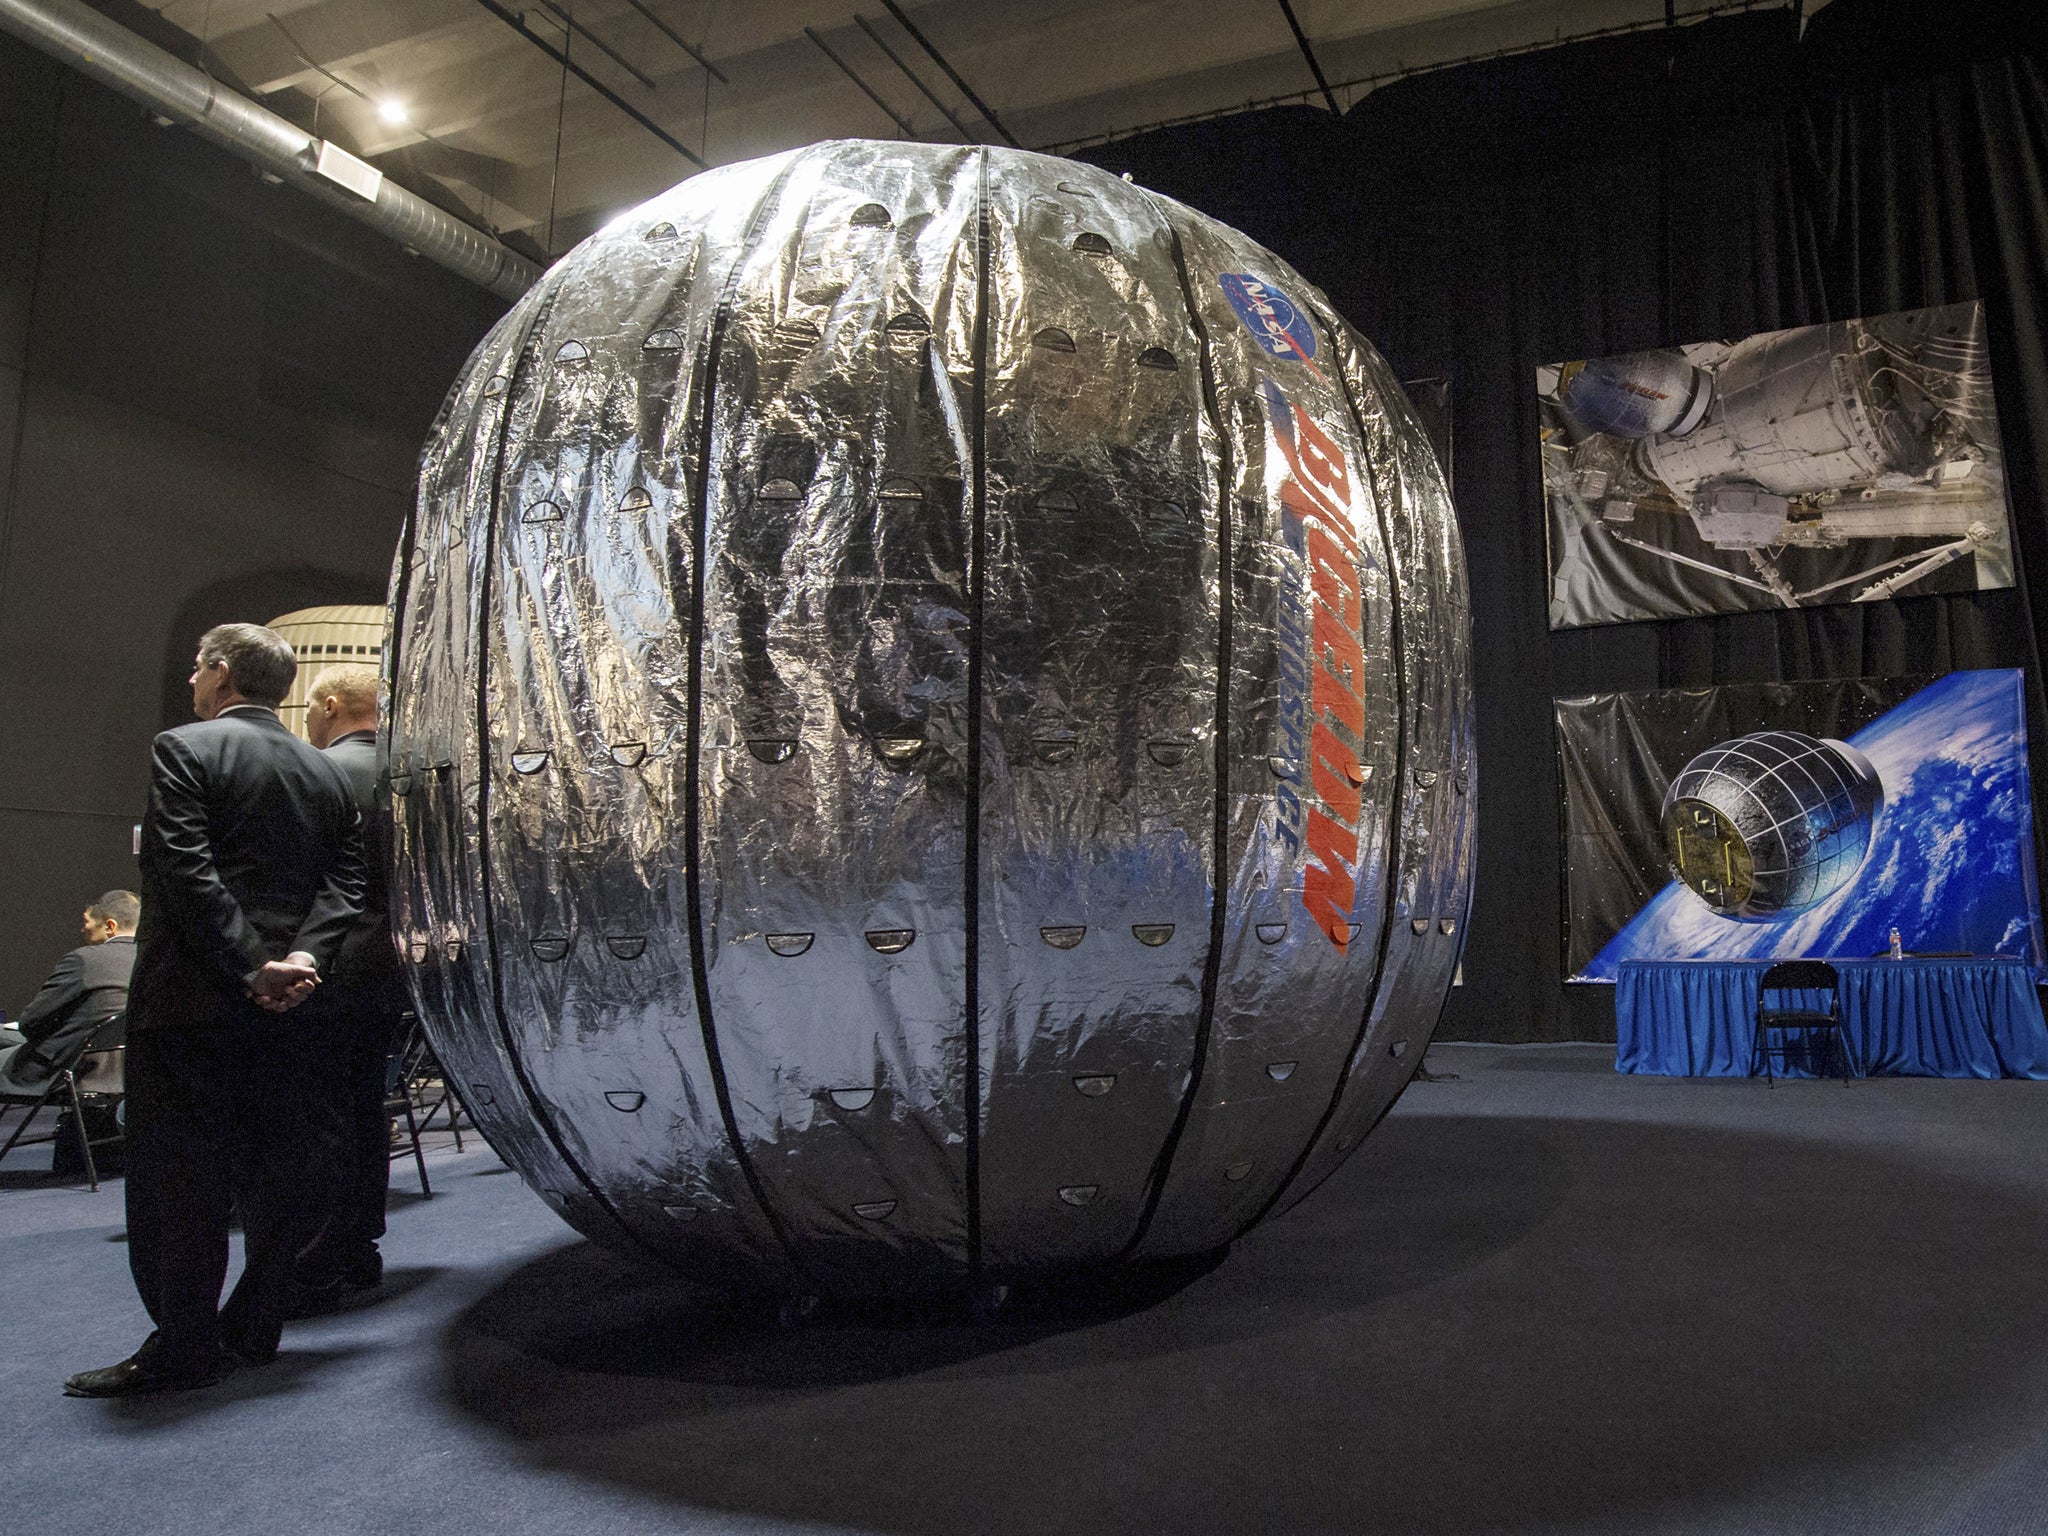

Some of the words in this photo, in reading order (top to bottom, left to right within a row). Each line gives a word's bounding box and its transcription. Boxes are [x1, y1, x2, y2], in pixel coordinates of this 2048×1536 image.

[1242, 281, 1292, 354] NASA
[1273, 399, 1366, 959] BIGELOW
[1275, 554, 1305, 858] AEROSPACE
